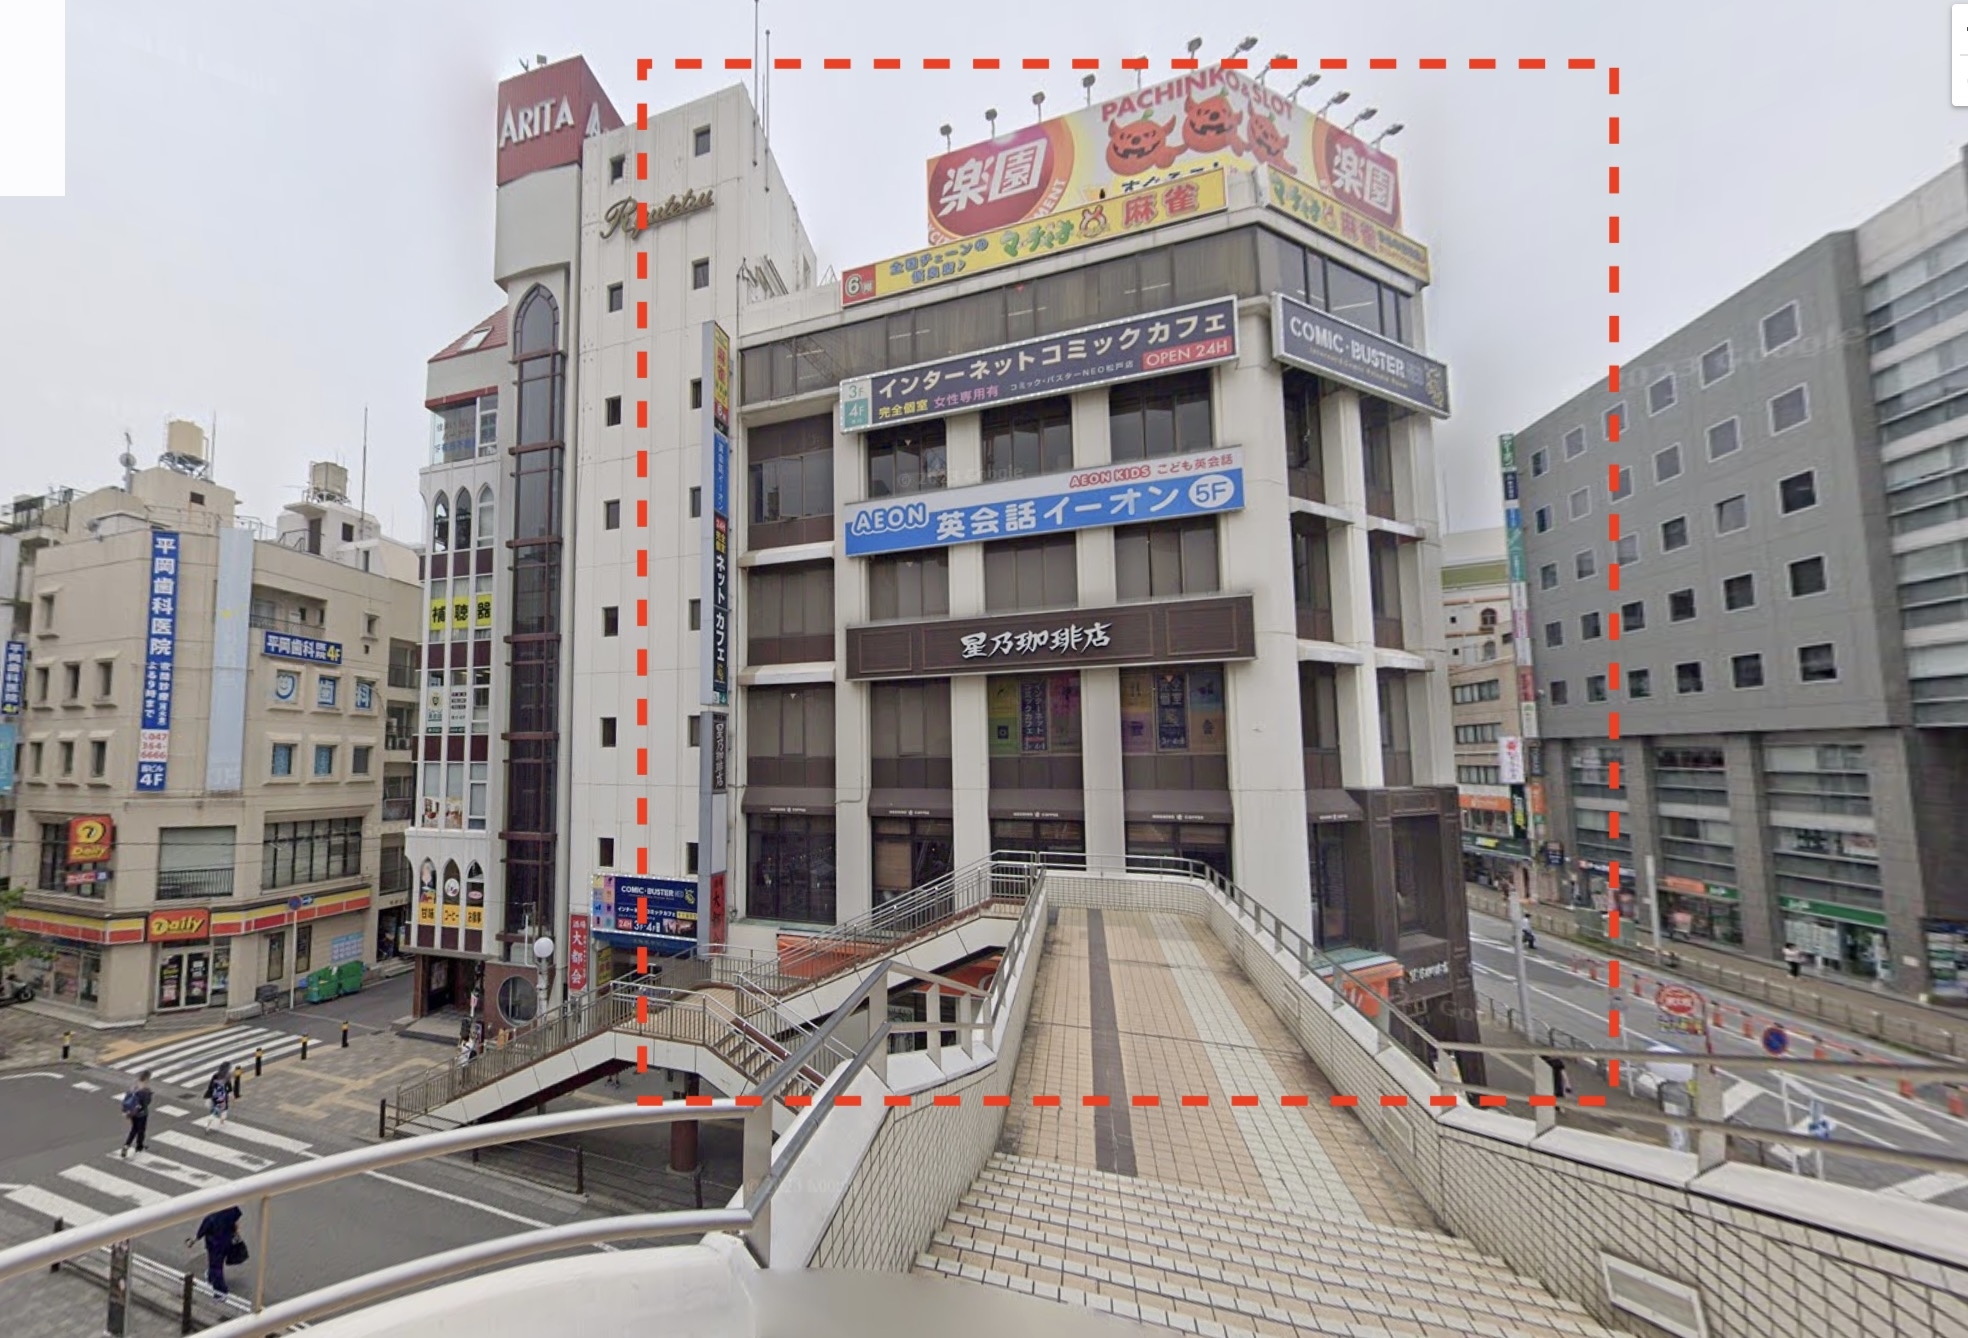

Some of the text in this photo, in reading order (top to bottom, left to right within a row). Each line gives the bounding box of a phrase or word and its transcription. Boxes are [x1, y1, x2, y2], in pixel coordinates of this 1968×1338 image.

[1101, 65, 1240, 122] PACHINKO
[1252, 87, 1294, 120] SLOT
[499, 95, 575, 149] ARITA
[938, 137, 1047, 217] 楽園
[1332, 143, 1396, 215] 楽園
[1122, 182, 1202, 226] 麻雀
[878, 311, 1227, 399] インターネットコミックカフェ
[1145, 340, 1228, 366] OPEN 24H
[849, 386, 864, 398] 3F
[879, 385, 999, 419] 完全個室 女性専用有
[849, 403, 864, 417] 4F
[1070, 454, 1234, 488] AEON KIDS こども英会話
[853, 479, 1229, 542] AEON 英会話 イーオン 5F
[149, 537, 176, 655] 平岡歯科医院
[432, 602, 491, 623] 補聴器
[327, 645, 341, 661] 4F
[960, 622, 1112, 659] 星乃珈琲店
[139, 773, 164, 786] 4F
[151, 915, 204, 935] Daily
[618, 919, 632, 929] 24H
[571, 931, 583, 984] 大都会
